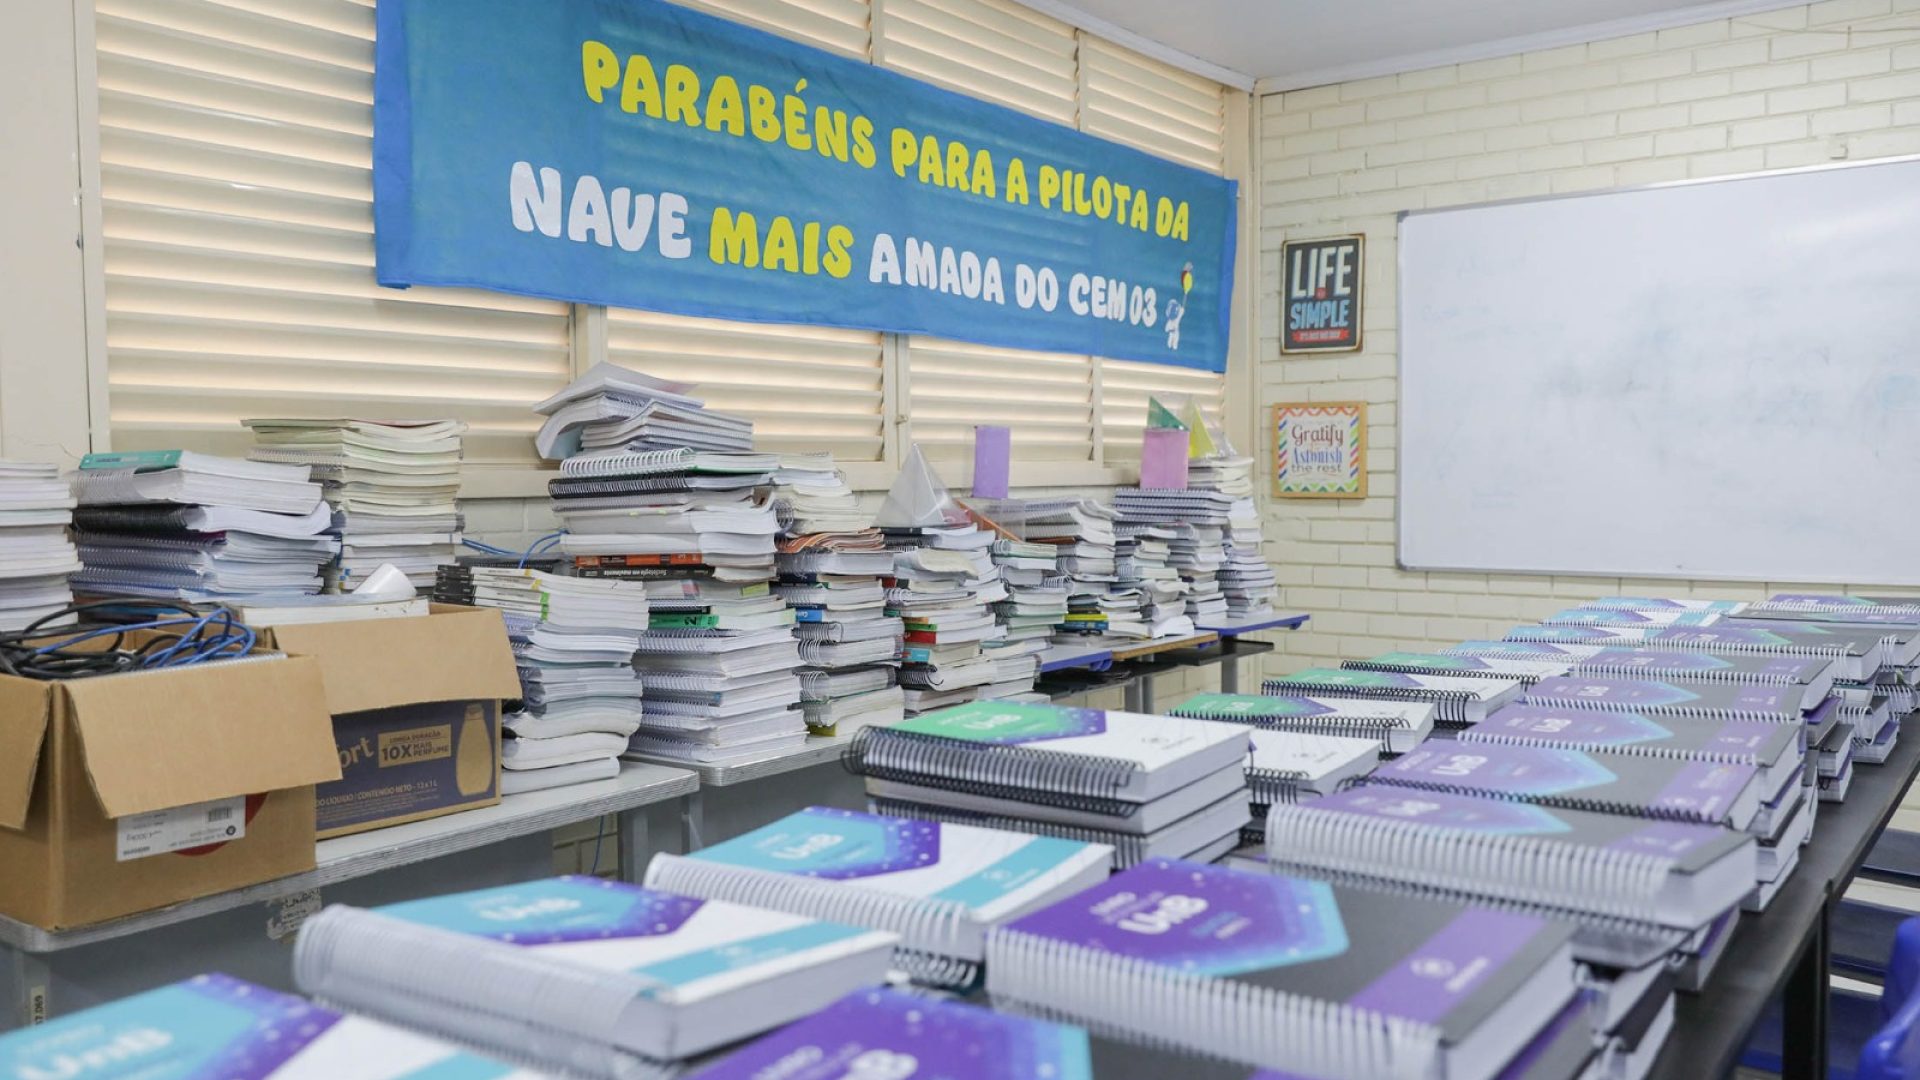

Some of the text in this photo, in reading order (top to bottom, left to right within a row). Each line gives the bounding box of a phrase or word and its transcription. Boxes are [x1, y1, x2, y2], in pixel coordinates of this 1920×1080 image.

[582, 40, 1190, 242] PARABÉNS PARA A PILOTA DA
[509, 160, 1158, 329] NAVE MAIS AMADA DO CEM 03
[1291, 244, 1355, 299] LIFE
[1289, 298, 1352, 330] SIMPLE
[1290, 422, 1345, 448] Gratify
[1291, 463, 1343, 475] the rest
[382, 743, 412, 761] 10X
[1117, 893, 1210, 935] UnB
